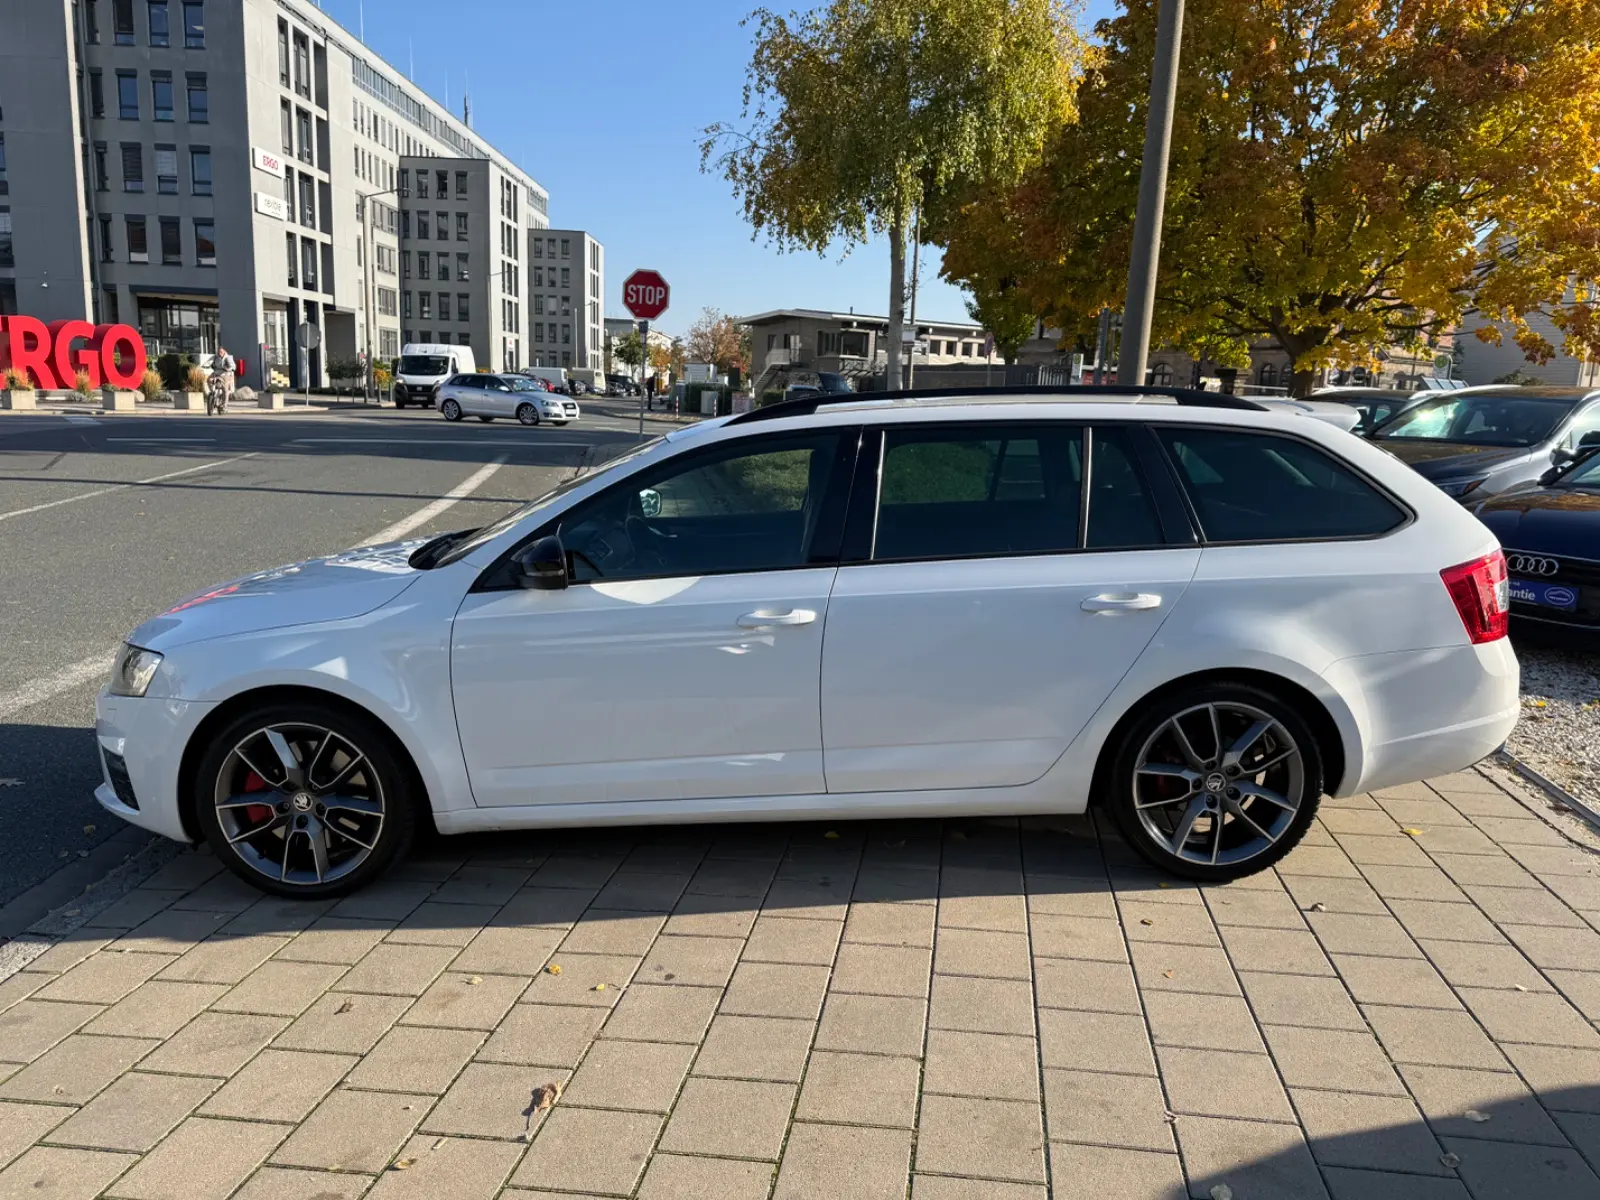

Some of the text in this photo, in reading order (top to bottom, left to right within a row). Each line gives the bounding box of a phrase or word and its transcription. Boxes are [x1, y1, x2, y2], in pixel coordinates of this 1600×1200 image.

[263, 155, 279, 171] ERGO
[627, 284, 665, 305] STOP
[0, 315, 147, 390] RGO
[1507, 588, 1536, 601] antie
